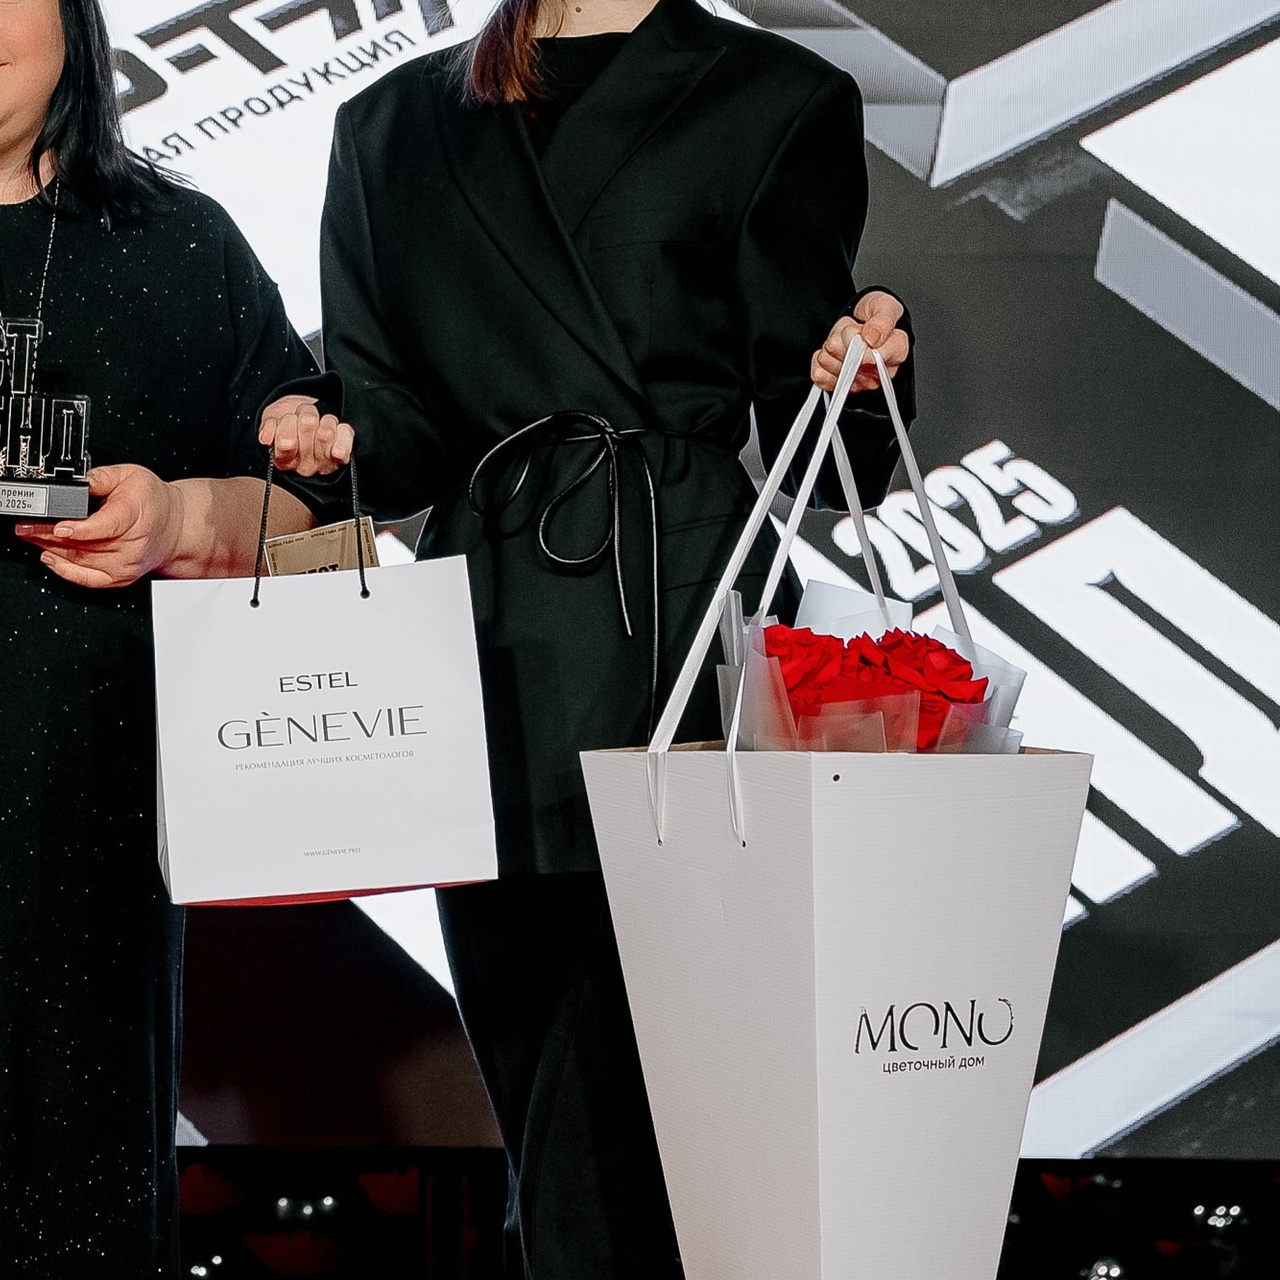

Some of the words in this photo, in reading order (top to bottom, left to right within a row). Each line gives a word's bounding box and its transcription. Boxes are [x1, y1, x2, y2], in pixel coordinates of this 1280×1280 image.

[194, 30, 418, 140] ПРОДУКЦИЯ
[1, 490, 35, 499] премии
[5, 499, 32, 509] 2025»
[831, 439, 1080, 604] 2025
[279, 671, 358, 693] ESTEL
[217, 705, 428, 750] GÈNEVIE
[235, 759, 305, 771] РЕКОМЕНДАЦИЯ
[306, 755, 344, 766] ЛУЧШИХ
[345, 750, 415, 763] КОСМЕТОЛОГОВ
[855, 997, 1015, 1054] MONO
[882, 1055, 956, 1075] цветочный
[958, 1055, 985, 1070] дом
